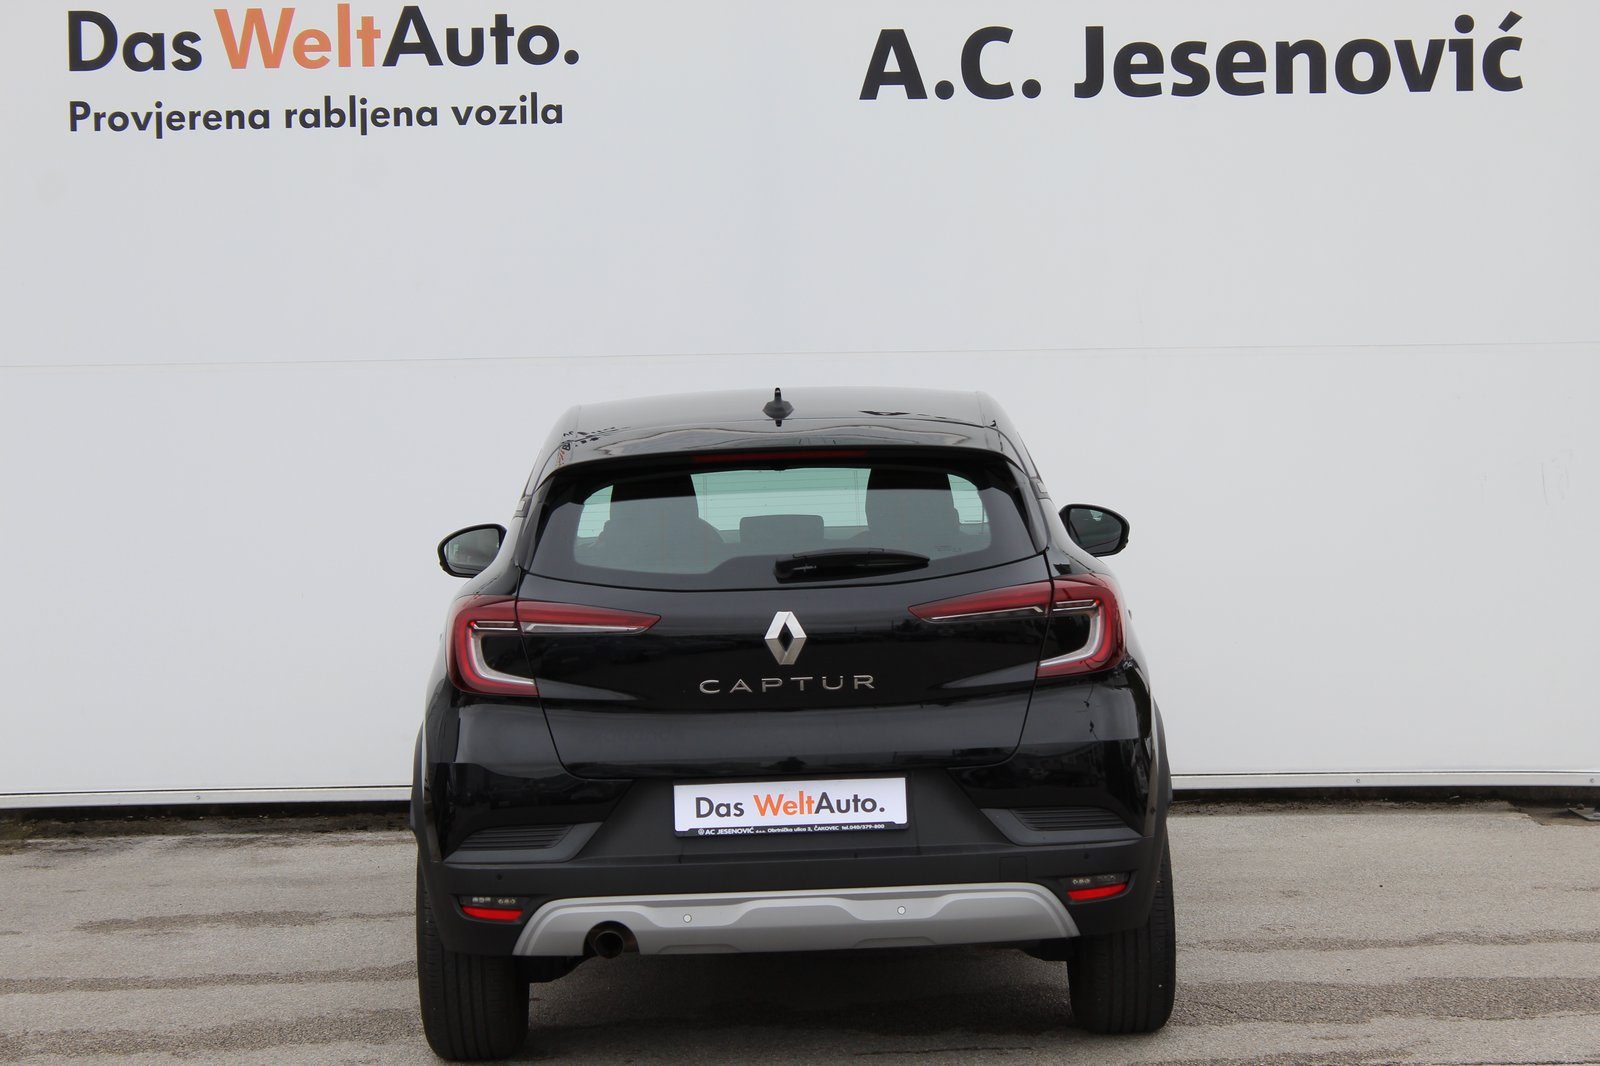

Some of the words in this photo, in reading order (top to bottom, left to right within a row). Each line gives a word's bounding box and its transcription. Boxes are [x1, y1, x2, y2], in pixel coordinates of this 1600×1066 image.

[68, 10, 202, 72] Das
[859, 26, 1042, 100] A.C.
[1074, 11, 1523, 98] Jesenović
[70, 101, 270, 139] Provjerena
[285, 95, 438, 135] rabljena
[451, 92, 563, 126] vozila
[695, 796, 745, 819] Das
[716, 827, 755, 835] JESENOVIĆ
